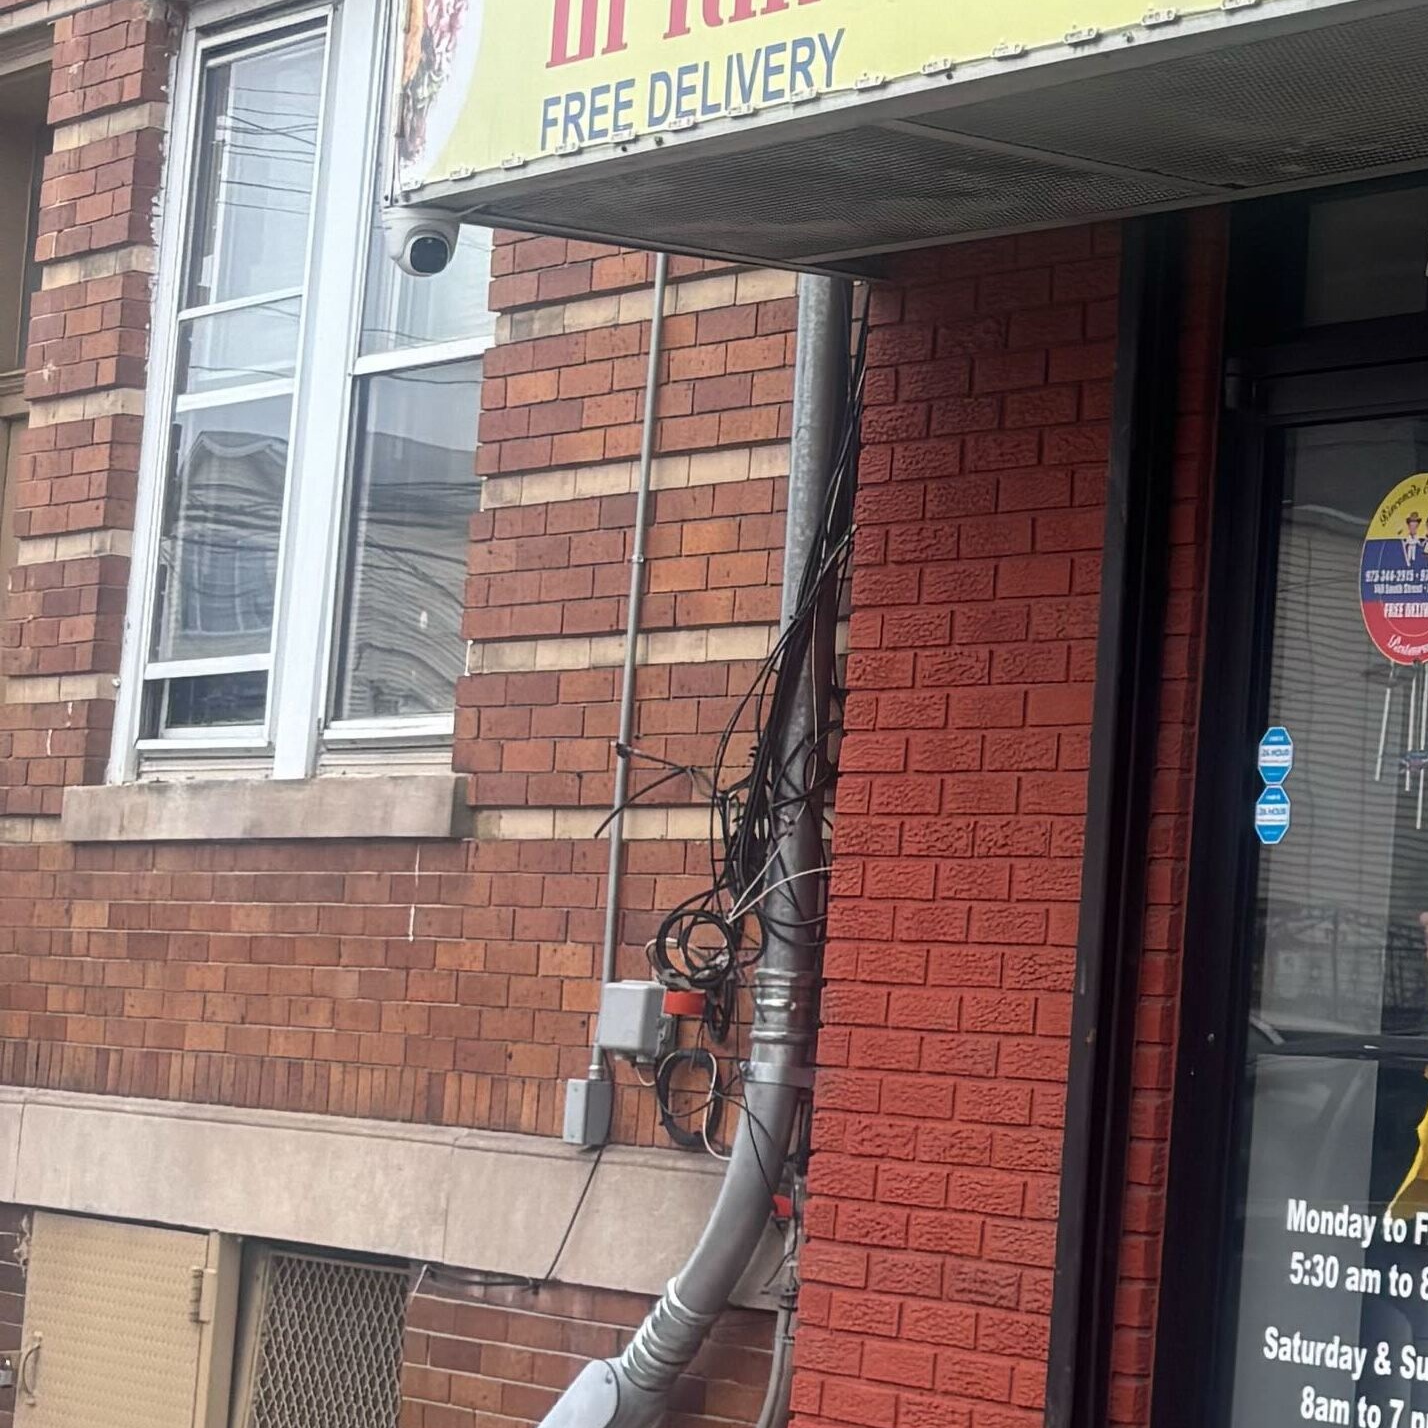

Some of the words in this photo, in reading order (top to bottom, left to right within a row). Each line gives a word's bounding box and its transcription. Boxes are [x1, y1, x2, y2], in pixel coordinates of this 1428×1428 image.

[540, 76, 637, 152] FREE
[647, 28, 847, 128] DELIVERY
[1286, 1198, 1377, 1248] Monday
[1384, 1215, 1407, 1243] to
[1289, 1252, 1339, 1289] 5:30
[1345, 1266, 1381, 1295] am
[1388, 1264, 1413, 1298] to
[1263, 1326, 1367, 1381] Saturday
[1373, 1341, 1392, 1376] &
[1300, 1385, 1350, 1426] 8am
